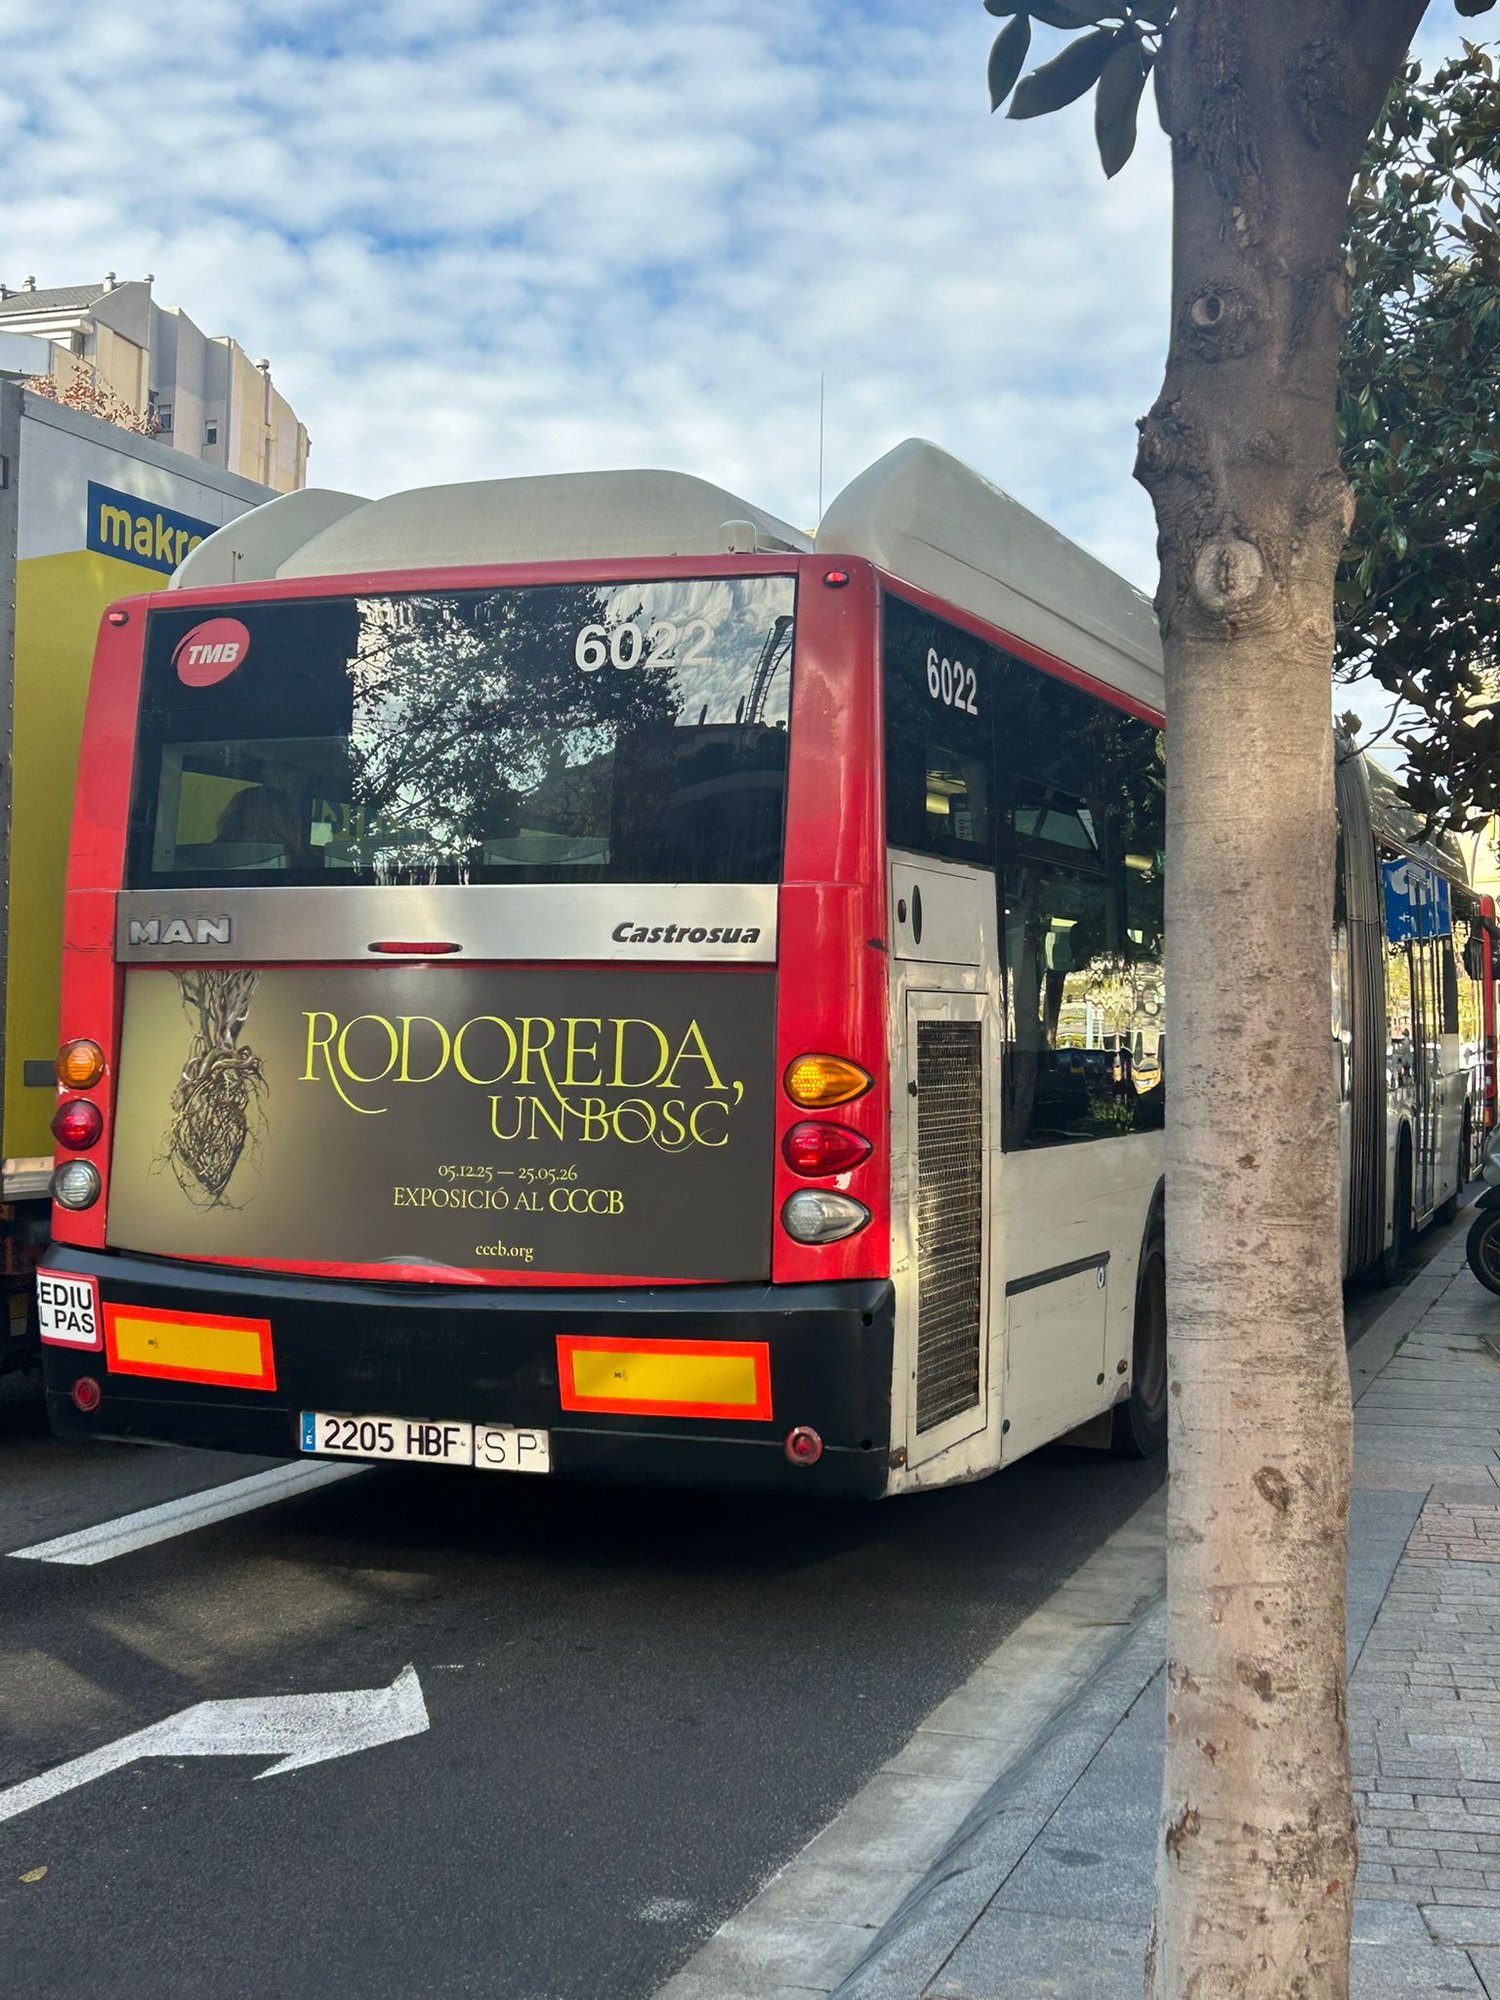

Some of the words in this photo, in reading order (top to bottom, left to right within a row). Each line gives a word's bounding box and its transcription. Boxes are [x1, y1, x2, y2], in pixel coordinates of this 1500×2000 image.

[188, 642, 239, 664] TMB
[574, 618, 714, 672] 6022
[926, 646, 979, 716] 6022
[129, 918, 231, 945] MAN
[611, 921, 761, 944] Castrosua
[298, 1011, 745, 1114] RODOREDA,
[487, 1095, 567, 1142] UN
[578, 1097, 730, 1150] BOSC
[437, 1164, 493, 1183] 05.12.25
[517, 1164, 578, 1185] 25.05.26
[393, 1186, 510, 1211] EXPOSICIÓ
[513, 1191, 544, 1211] AL
[548, 1187, 624, 1215] CCCB
[475, 1240, 534, 1263] cccb.org
[38, 1281, 93, 1310] EDIU
[54, 1308, 95, 1334] PAS
[324, 1418, 395, 1454] 2205
[406, 1423, 461, 1457] HBF
